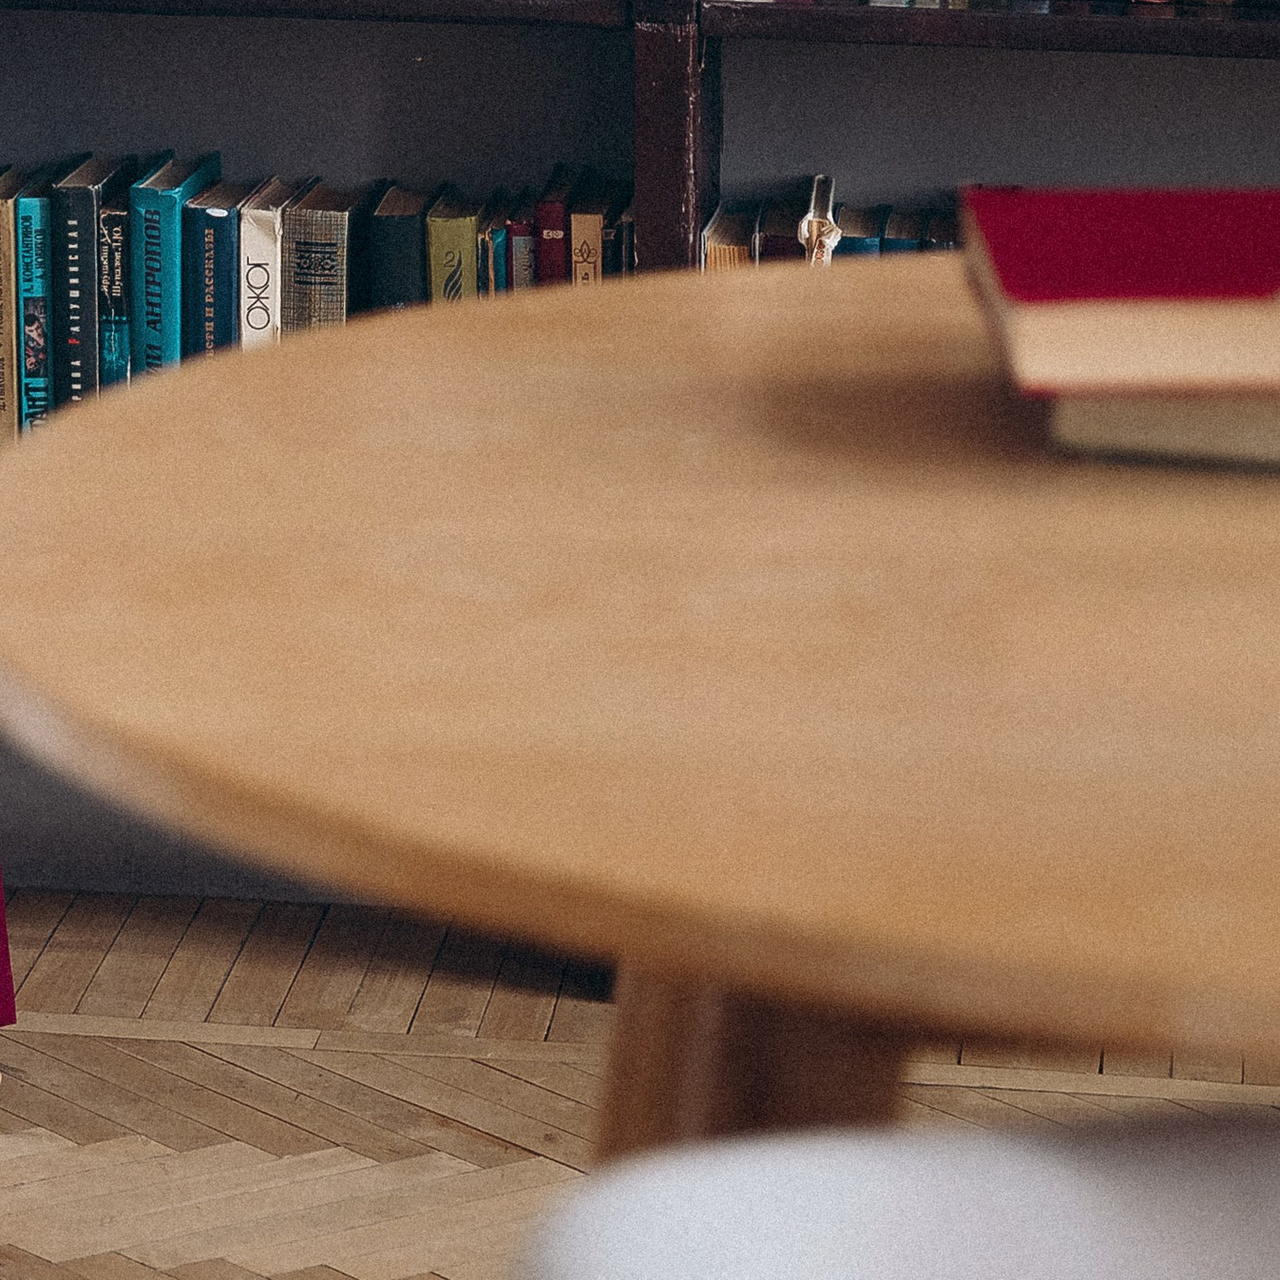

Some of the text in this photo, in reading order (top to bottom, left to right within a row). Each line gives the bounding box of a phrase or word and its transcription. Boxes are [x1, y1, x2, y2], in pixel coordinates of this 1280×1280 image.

[20, 215, 34, 283] КОНСТАНТИНОВ
[144, 209, 163, 334] АНТРОПОВ
[205, 228, 215, 303] РАССКАЗЫ
[246, 256, 271, 330] ОЖОГ
